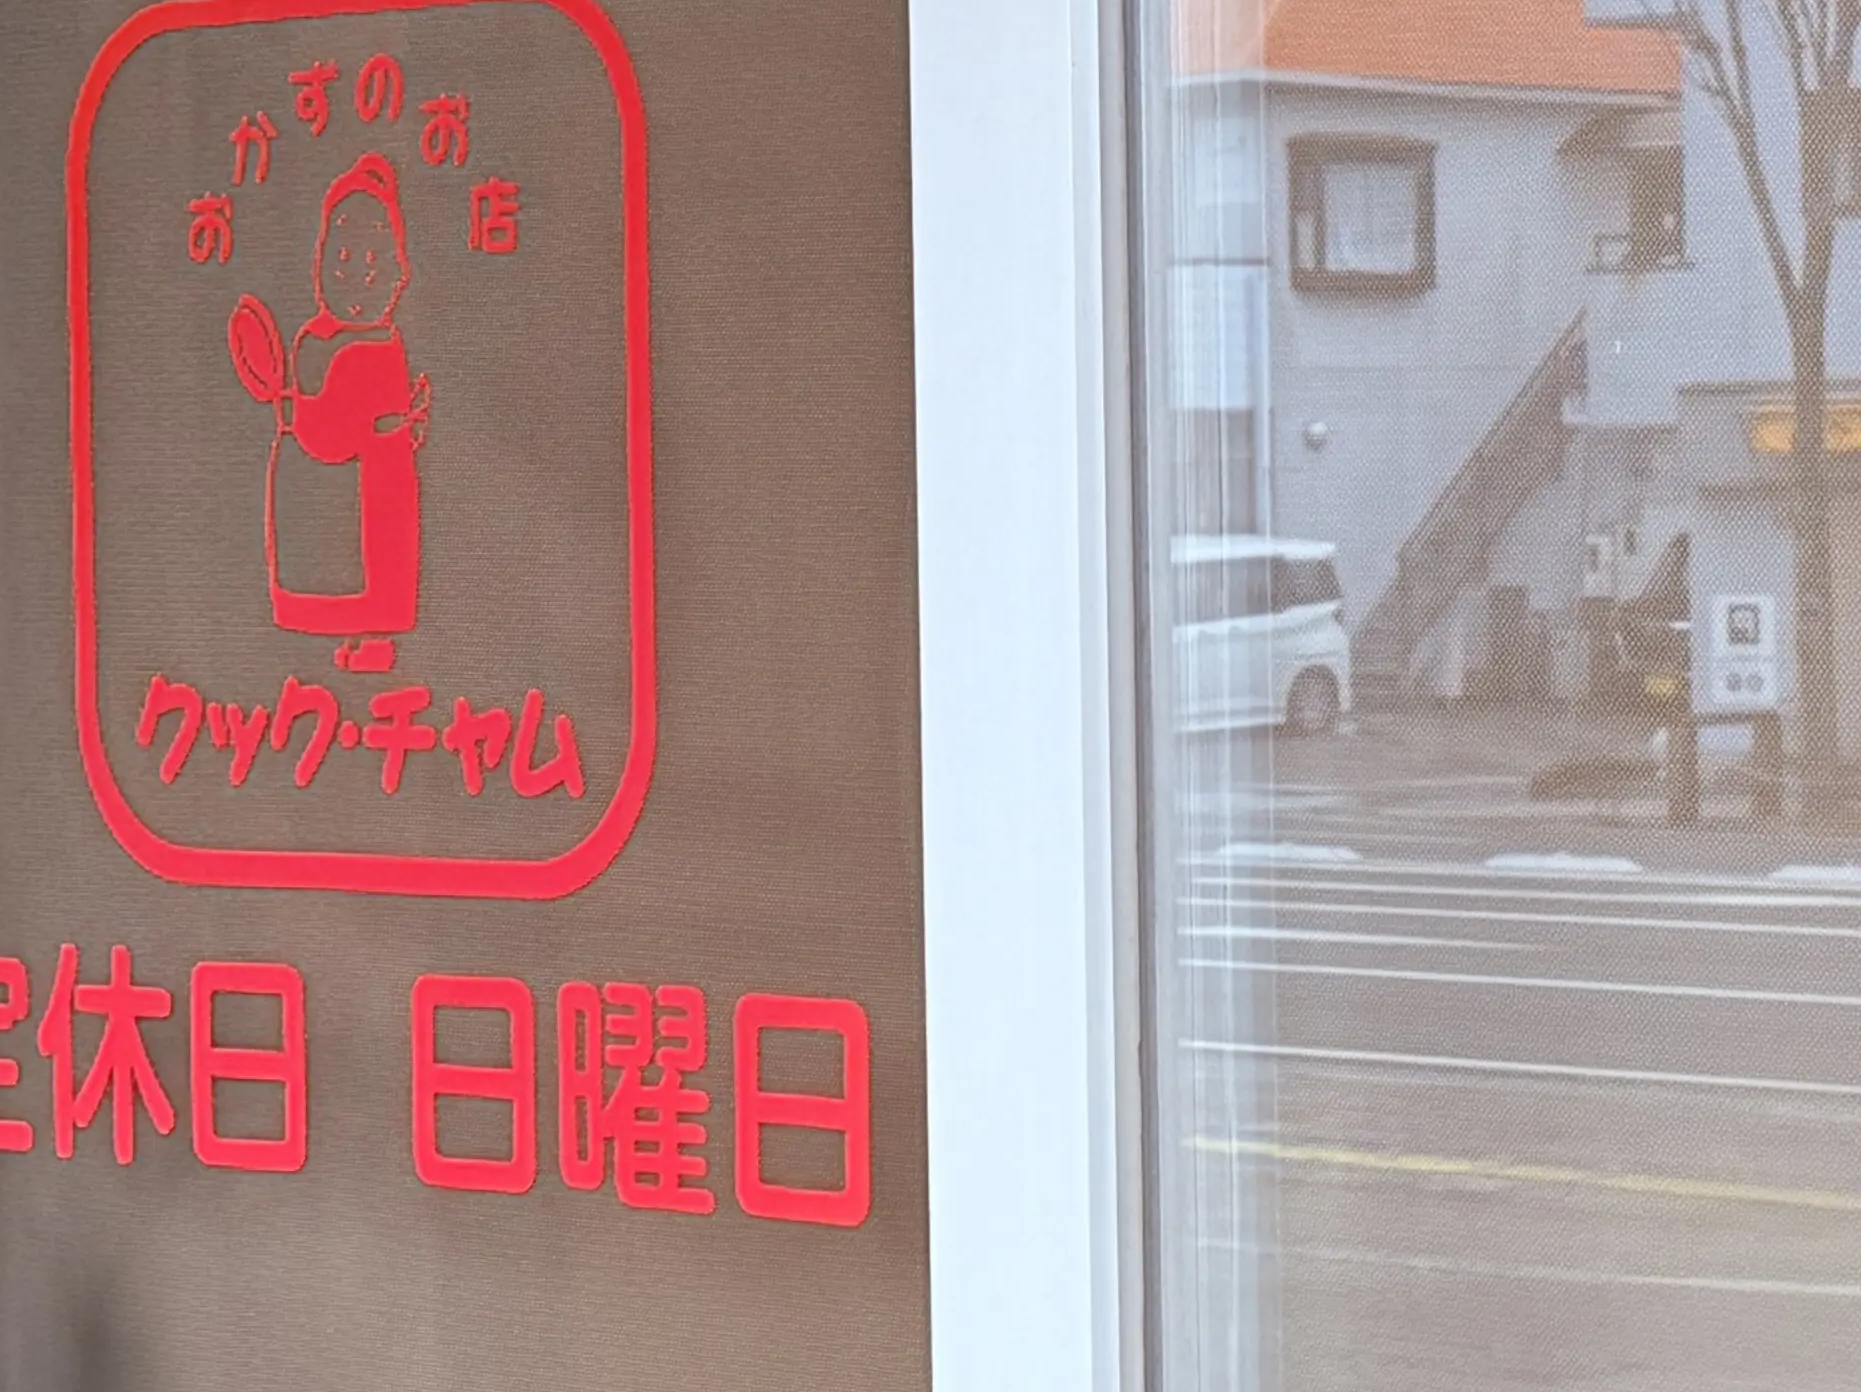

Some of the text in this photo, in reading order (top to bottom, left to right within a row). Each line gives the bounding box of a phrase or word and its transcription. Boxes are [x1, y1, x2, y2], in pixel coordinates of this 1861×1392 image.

[187, 53, 521, 264] おかずのお店
[139, 674, 585, 799] クック・チャム
[411, 973, 871, 1228] 日曜日
